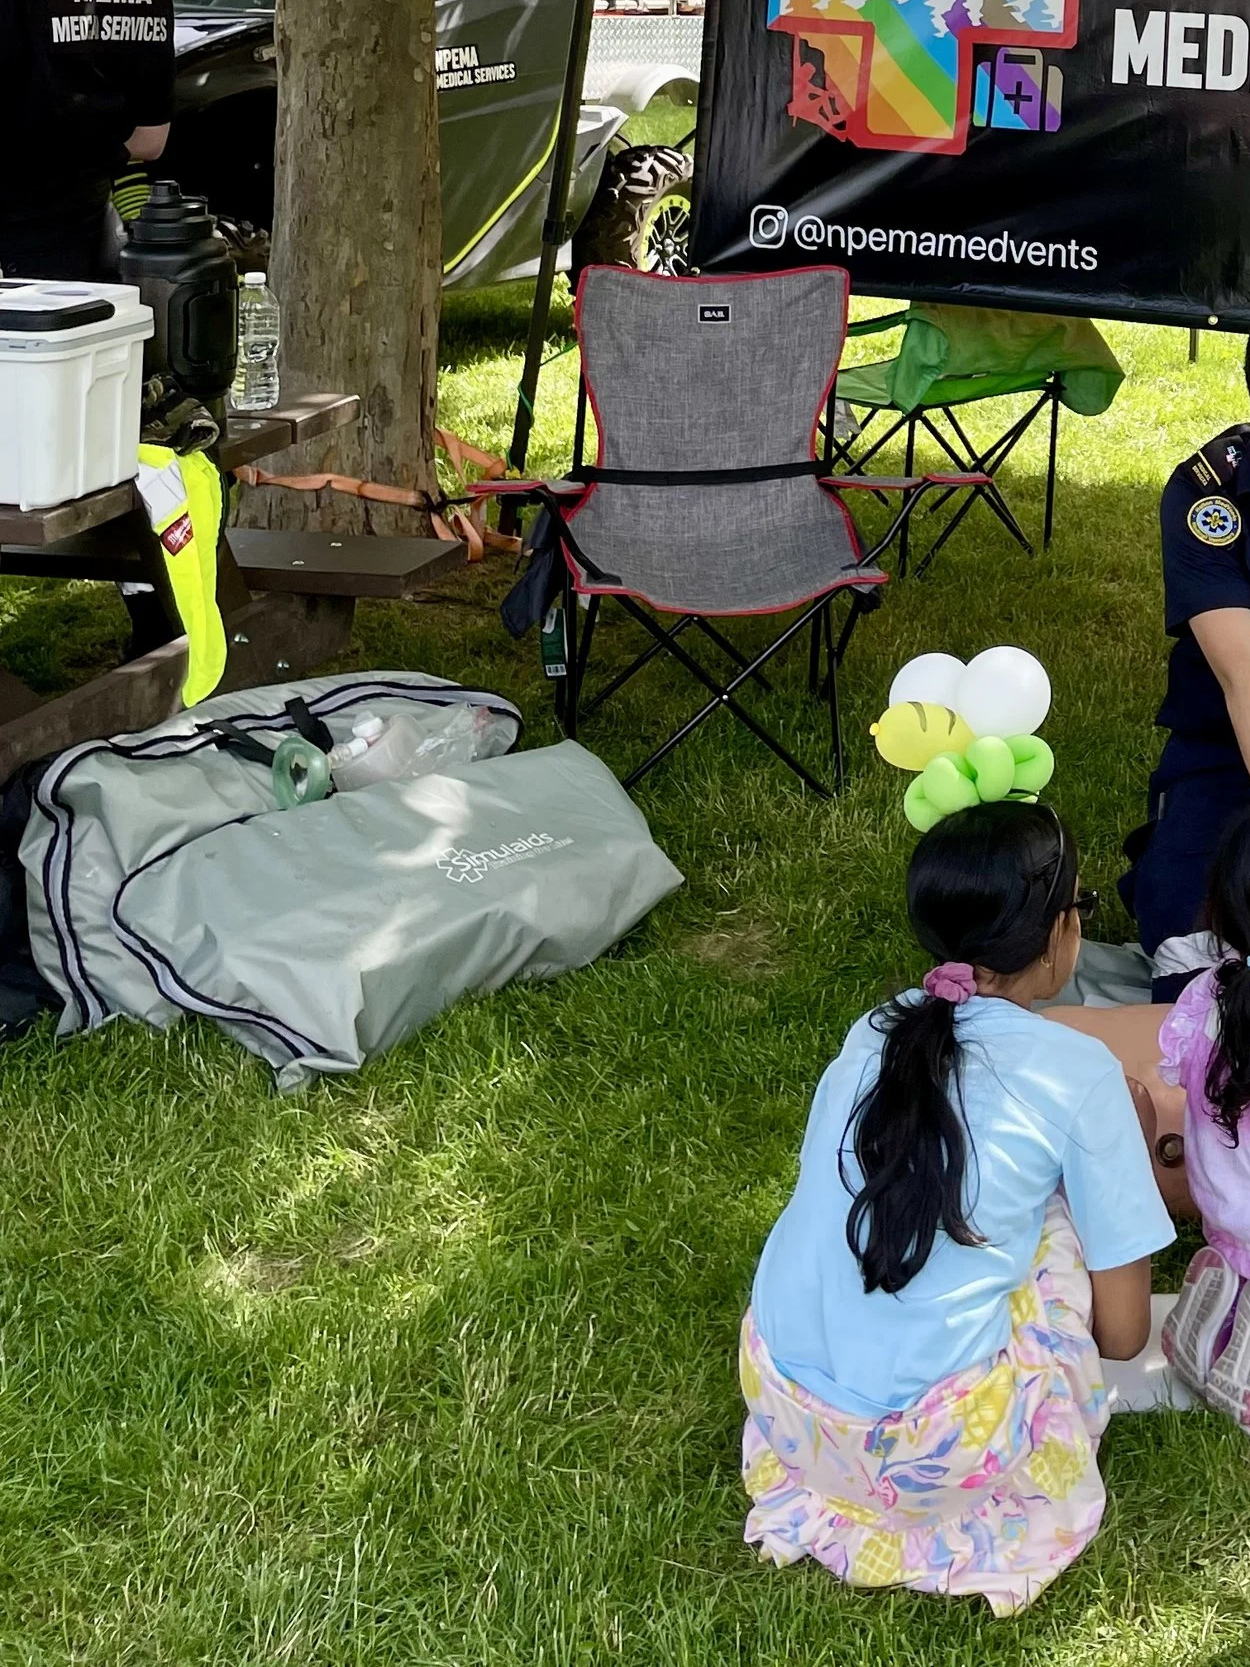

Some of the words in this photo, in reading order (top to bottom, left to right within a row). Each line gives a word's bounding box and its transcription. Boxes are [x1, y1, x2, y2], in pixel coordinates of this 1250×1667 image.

[101, 15, 167, 42] SERVICES
[435, 46, 479, 72] NPEMA
[436, 70, 473, 89] MEDICAL
[474, 63, 515, 84] SERVICES
[793, 214, 1098, 271] @npemamedvents
[451, 832, 554, 872] Simulaids
